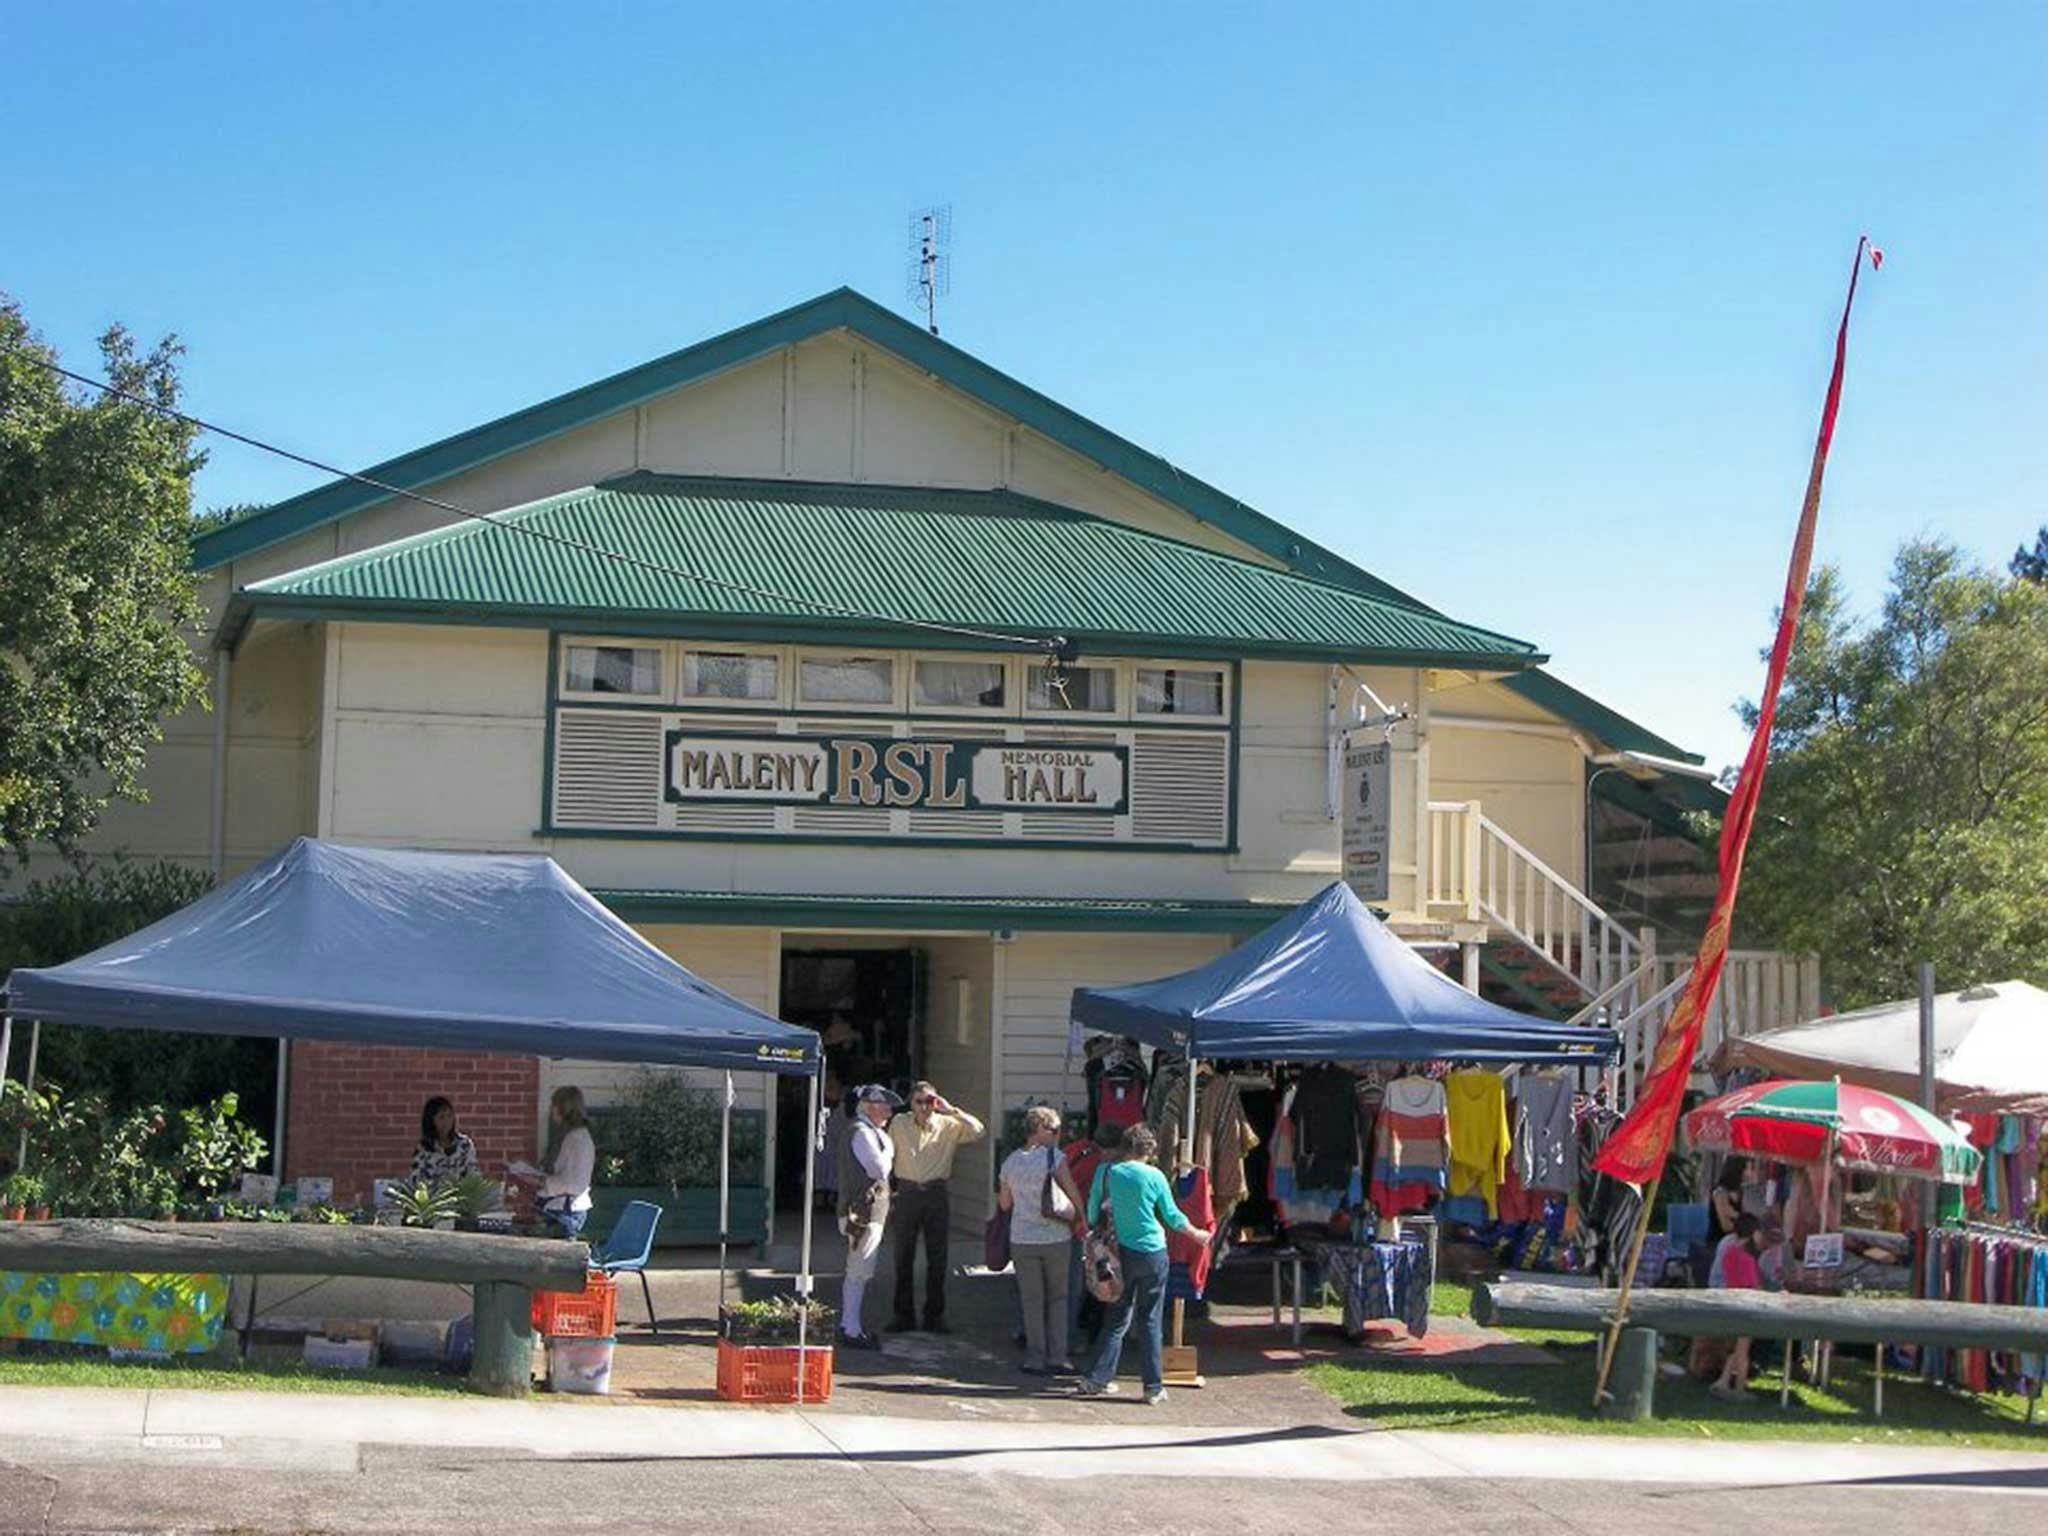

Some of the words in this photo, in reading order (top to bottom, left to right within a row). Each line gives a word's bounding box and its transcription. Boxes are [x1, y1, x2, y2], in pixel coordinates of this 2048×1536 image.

[681, 751, 821, 791] MALENY
[830, 740, 966, 807] RSL
[1001, 751, 1095, 767] MEMORIAL
[1004, 765, 1097, 803] HALL
